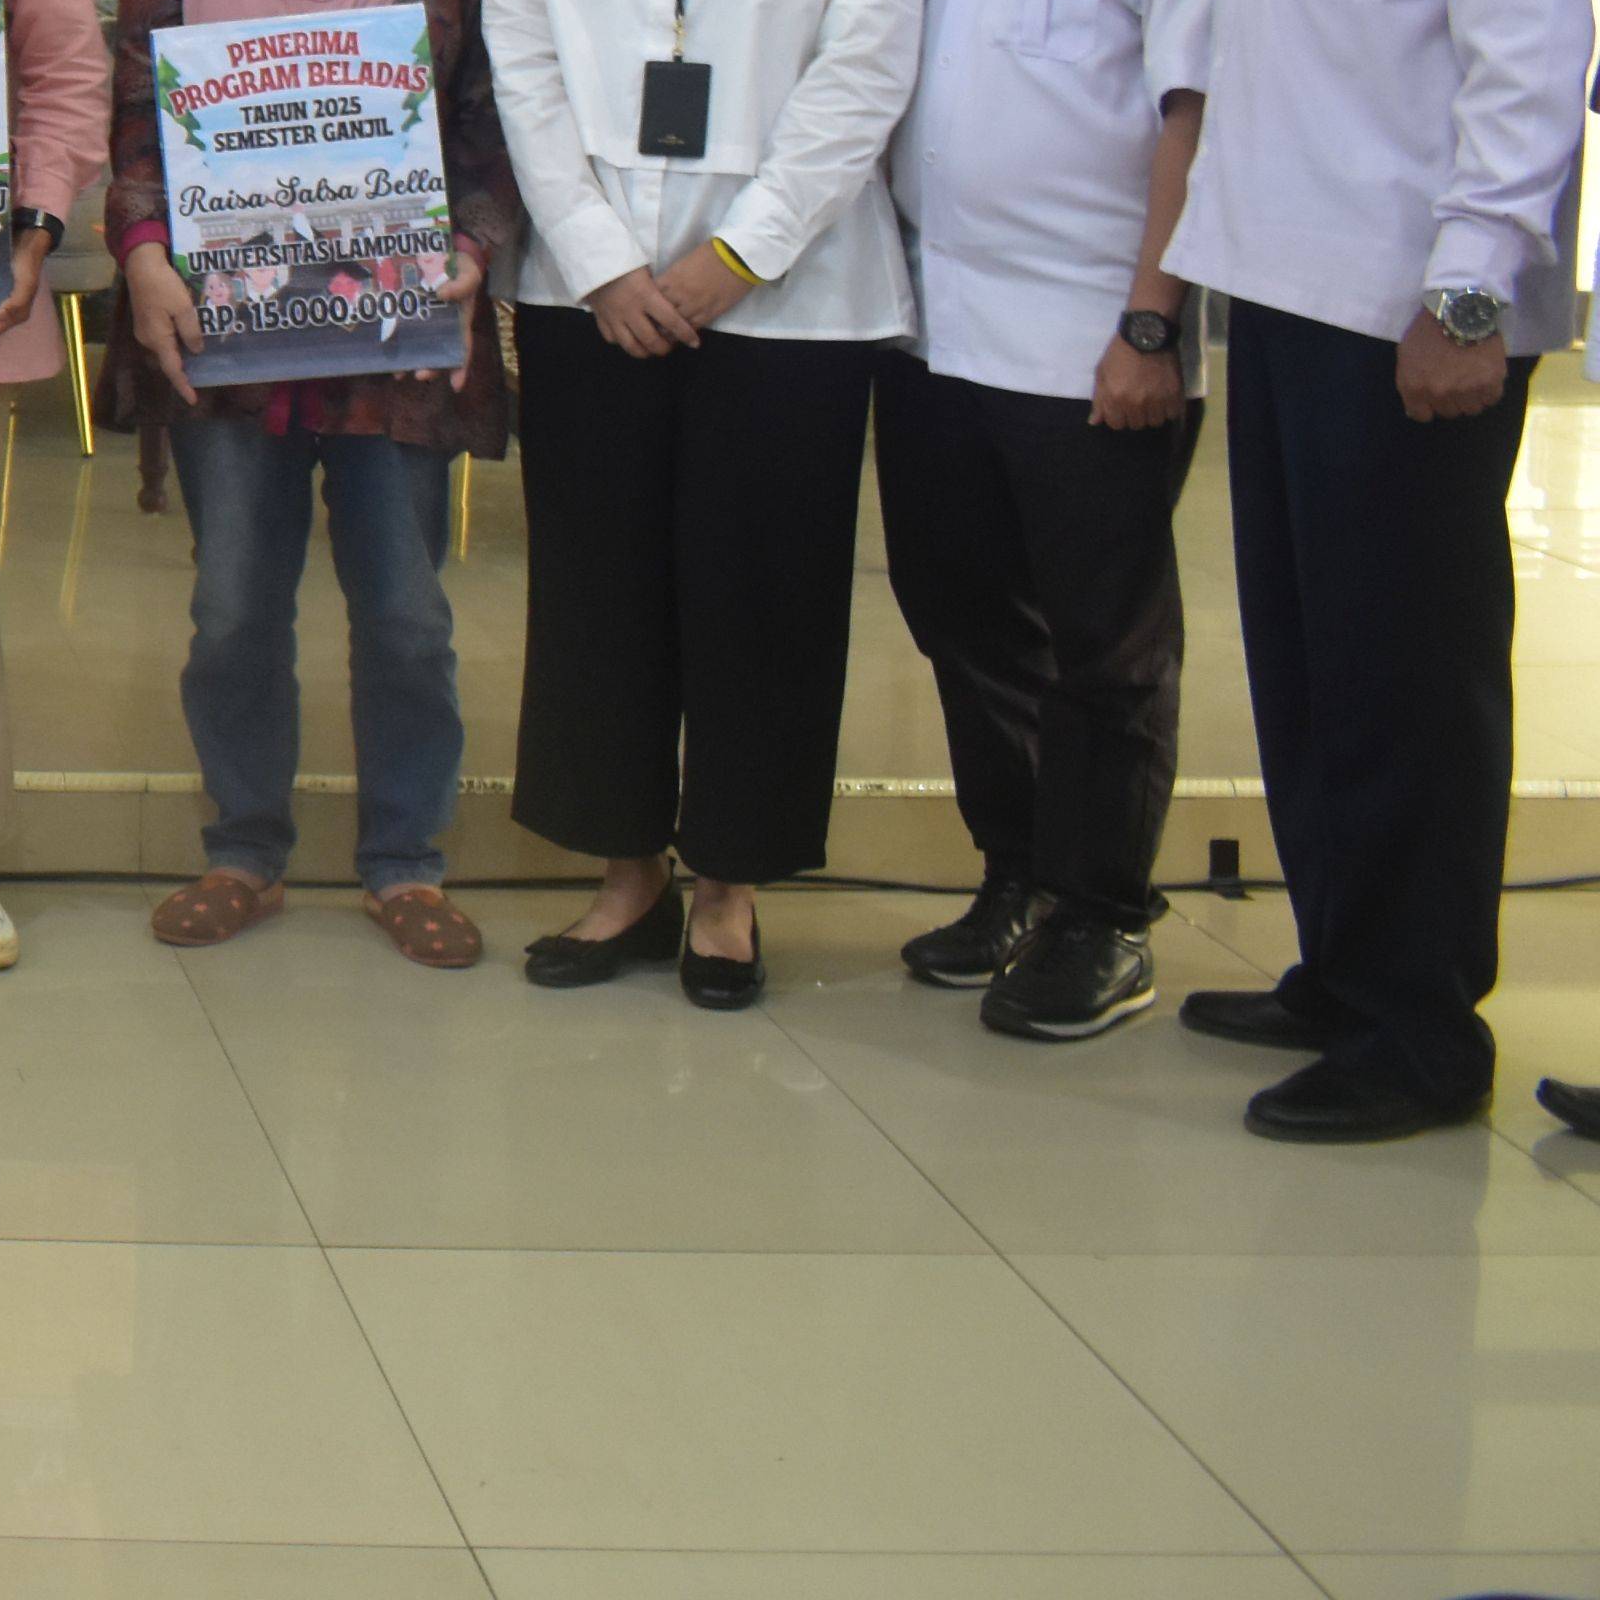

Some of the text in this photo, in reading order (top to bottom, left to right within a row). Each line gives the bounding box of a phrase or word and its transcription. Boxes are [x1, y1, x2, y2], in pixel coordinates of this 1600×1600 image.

[226, 31, 360, 68] PENERIMA
[169, 61, 430, 117] PROGRAM BELADAS
[239, 96, 362, 125] TAHUN 2025
[214, 118, 393, 152] SEMESTER GANJIL
[180, 168, 446, 217] Raisa Salsa Bella
[188, 230, 443, 273] UNIVERSITAS LAMPUNG
[199, 305, 243, 335] RP.
